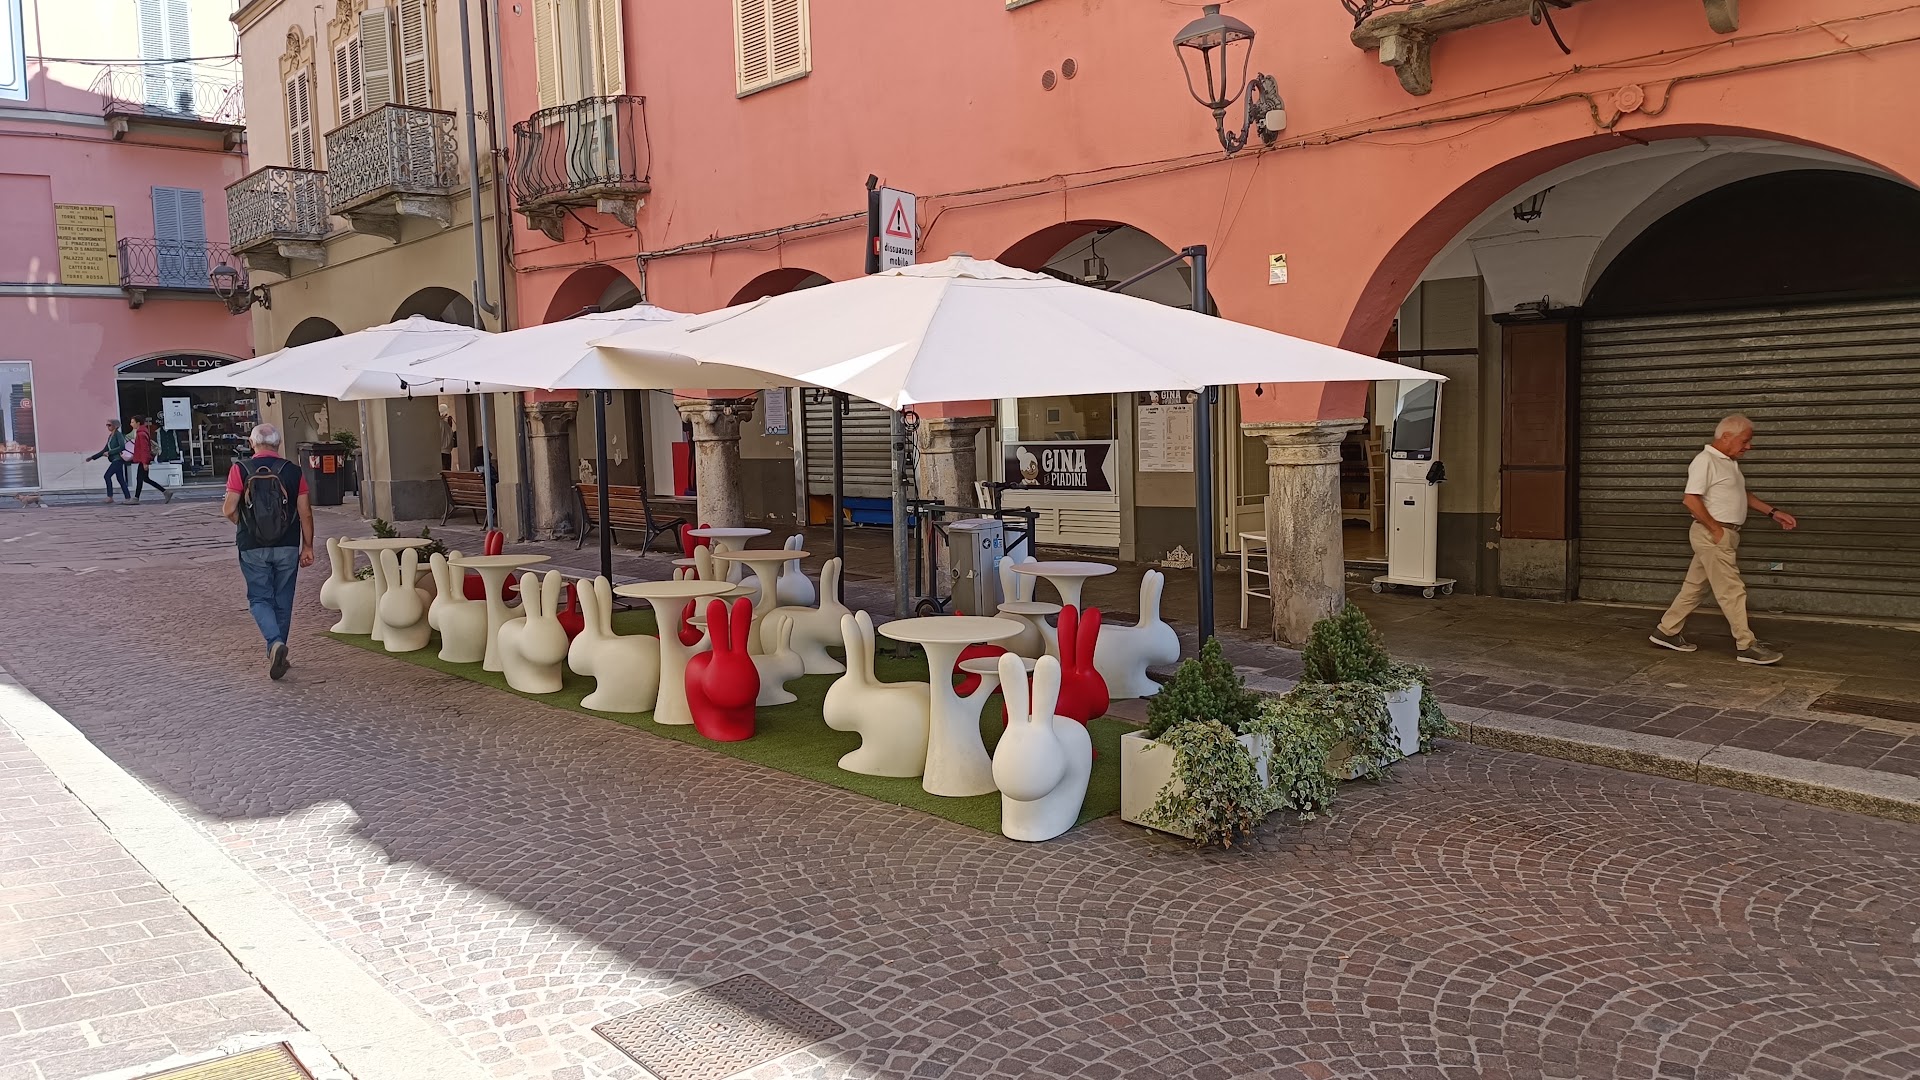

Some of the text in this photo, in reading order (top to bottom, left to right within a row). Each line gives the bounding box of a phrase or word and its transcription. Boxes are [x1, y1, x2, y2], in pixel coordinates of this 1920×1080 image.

[884, 242, 913, 256] dissuasore
[890, 257, 908, 266] mobile
[156, 359, 222, 368] PULL LOVE
[1160, 390, 1182, 400] GINA
[1041, 449, 1088, 473] GINA
[1051, 472, 1088, 487] PIADINA
